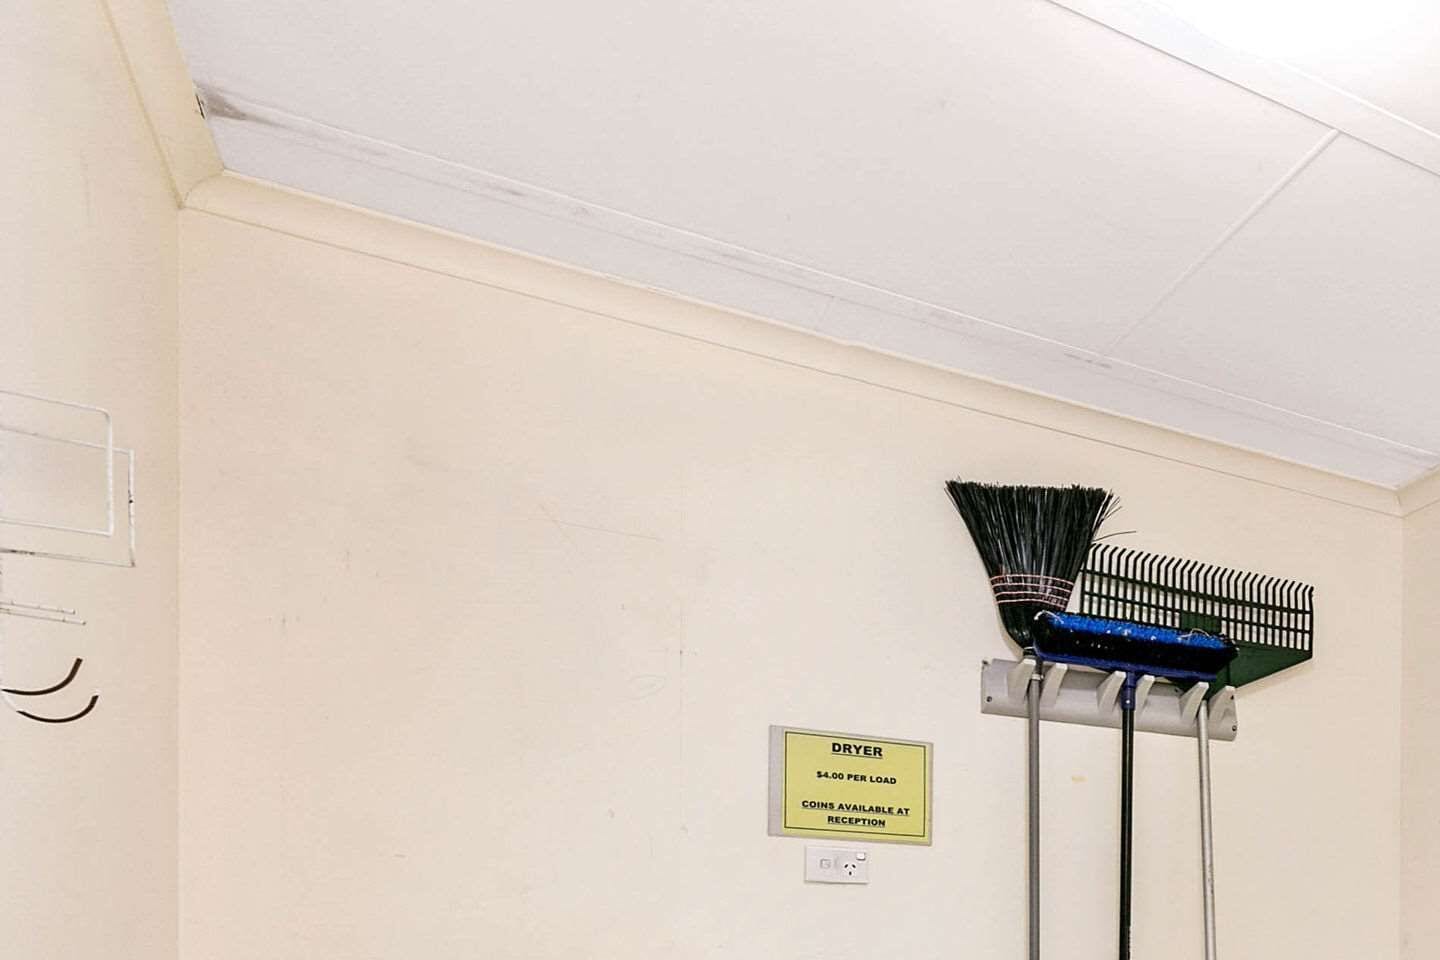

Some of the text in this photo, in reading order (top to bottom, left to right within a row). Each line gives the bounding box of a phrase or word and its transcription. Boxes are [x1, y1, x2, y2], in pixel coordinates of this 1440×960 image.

[832, 743, 883, 757] DRYER
[816, 771, 897, 785] $4.00 PER LOAD
[802, 800, 911, 816] COINS AVAILABLE AT
[827, 815, 886, 828] RECEPTION
